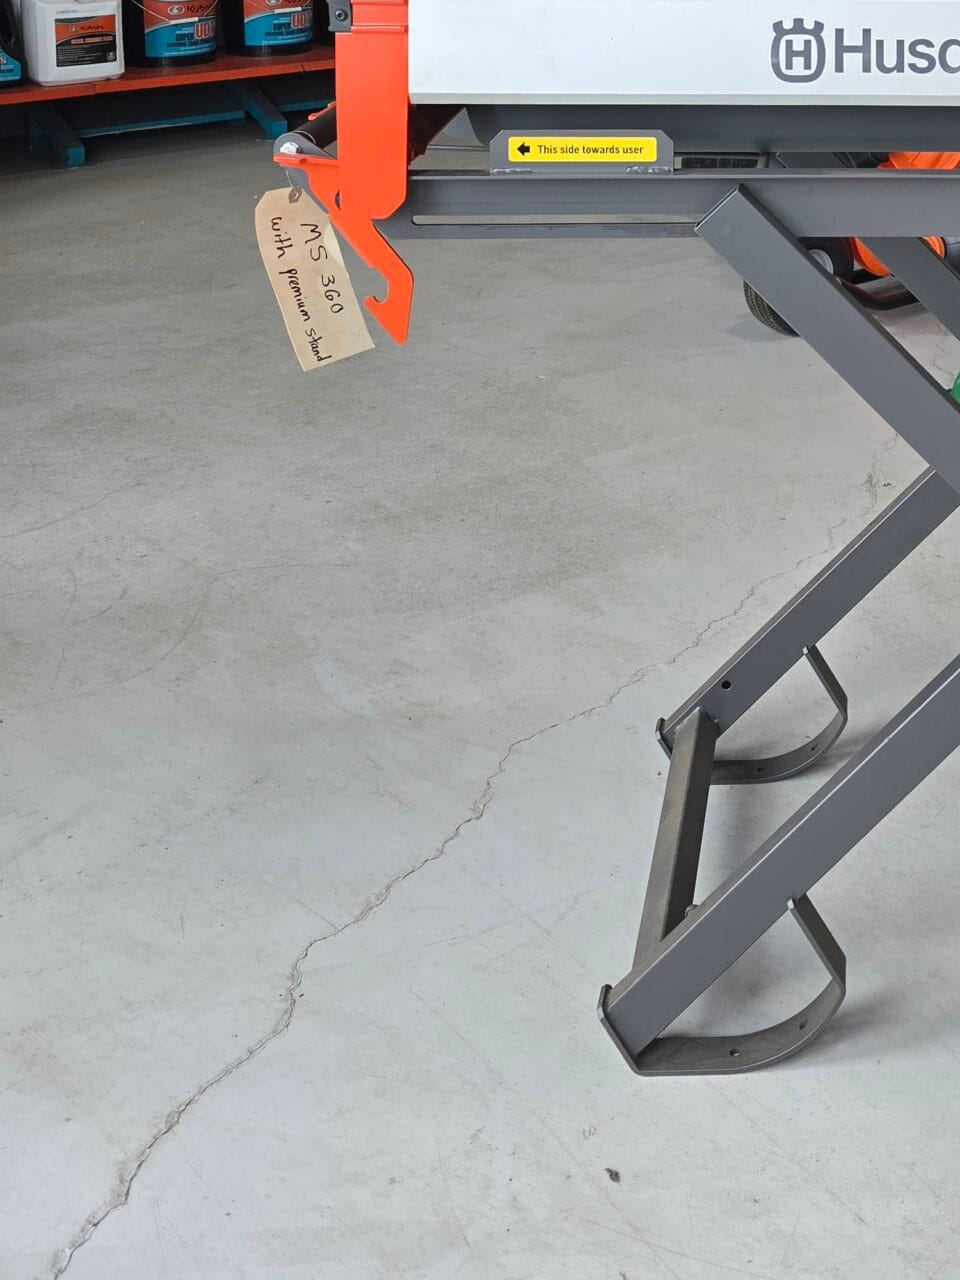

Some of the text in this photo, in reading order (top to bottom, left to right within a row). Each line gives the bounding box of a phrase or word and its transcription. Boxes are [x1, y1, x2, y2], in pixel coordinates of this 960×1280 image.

[537, 144, 644, 154] This side towards user
[271, 216, 333, 362] with premium stand
[321, 274, 344, 314] 360
